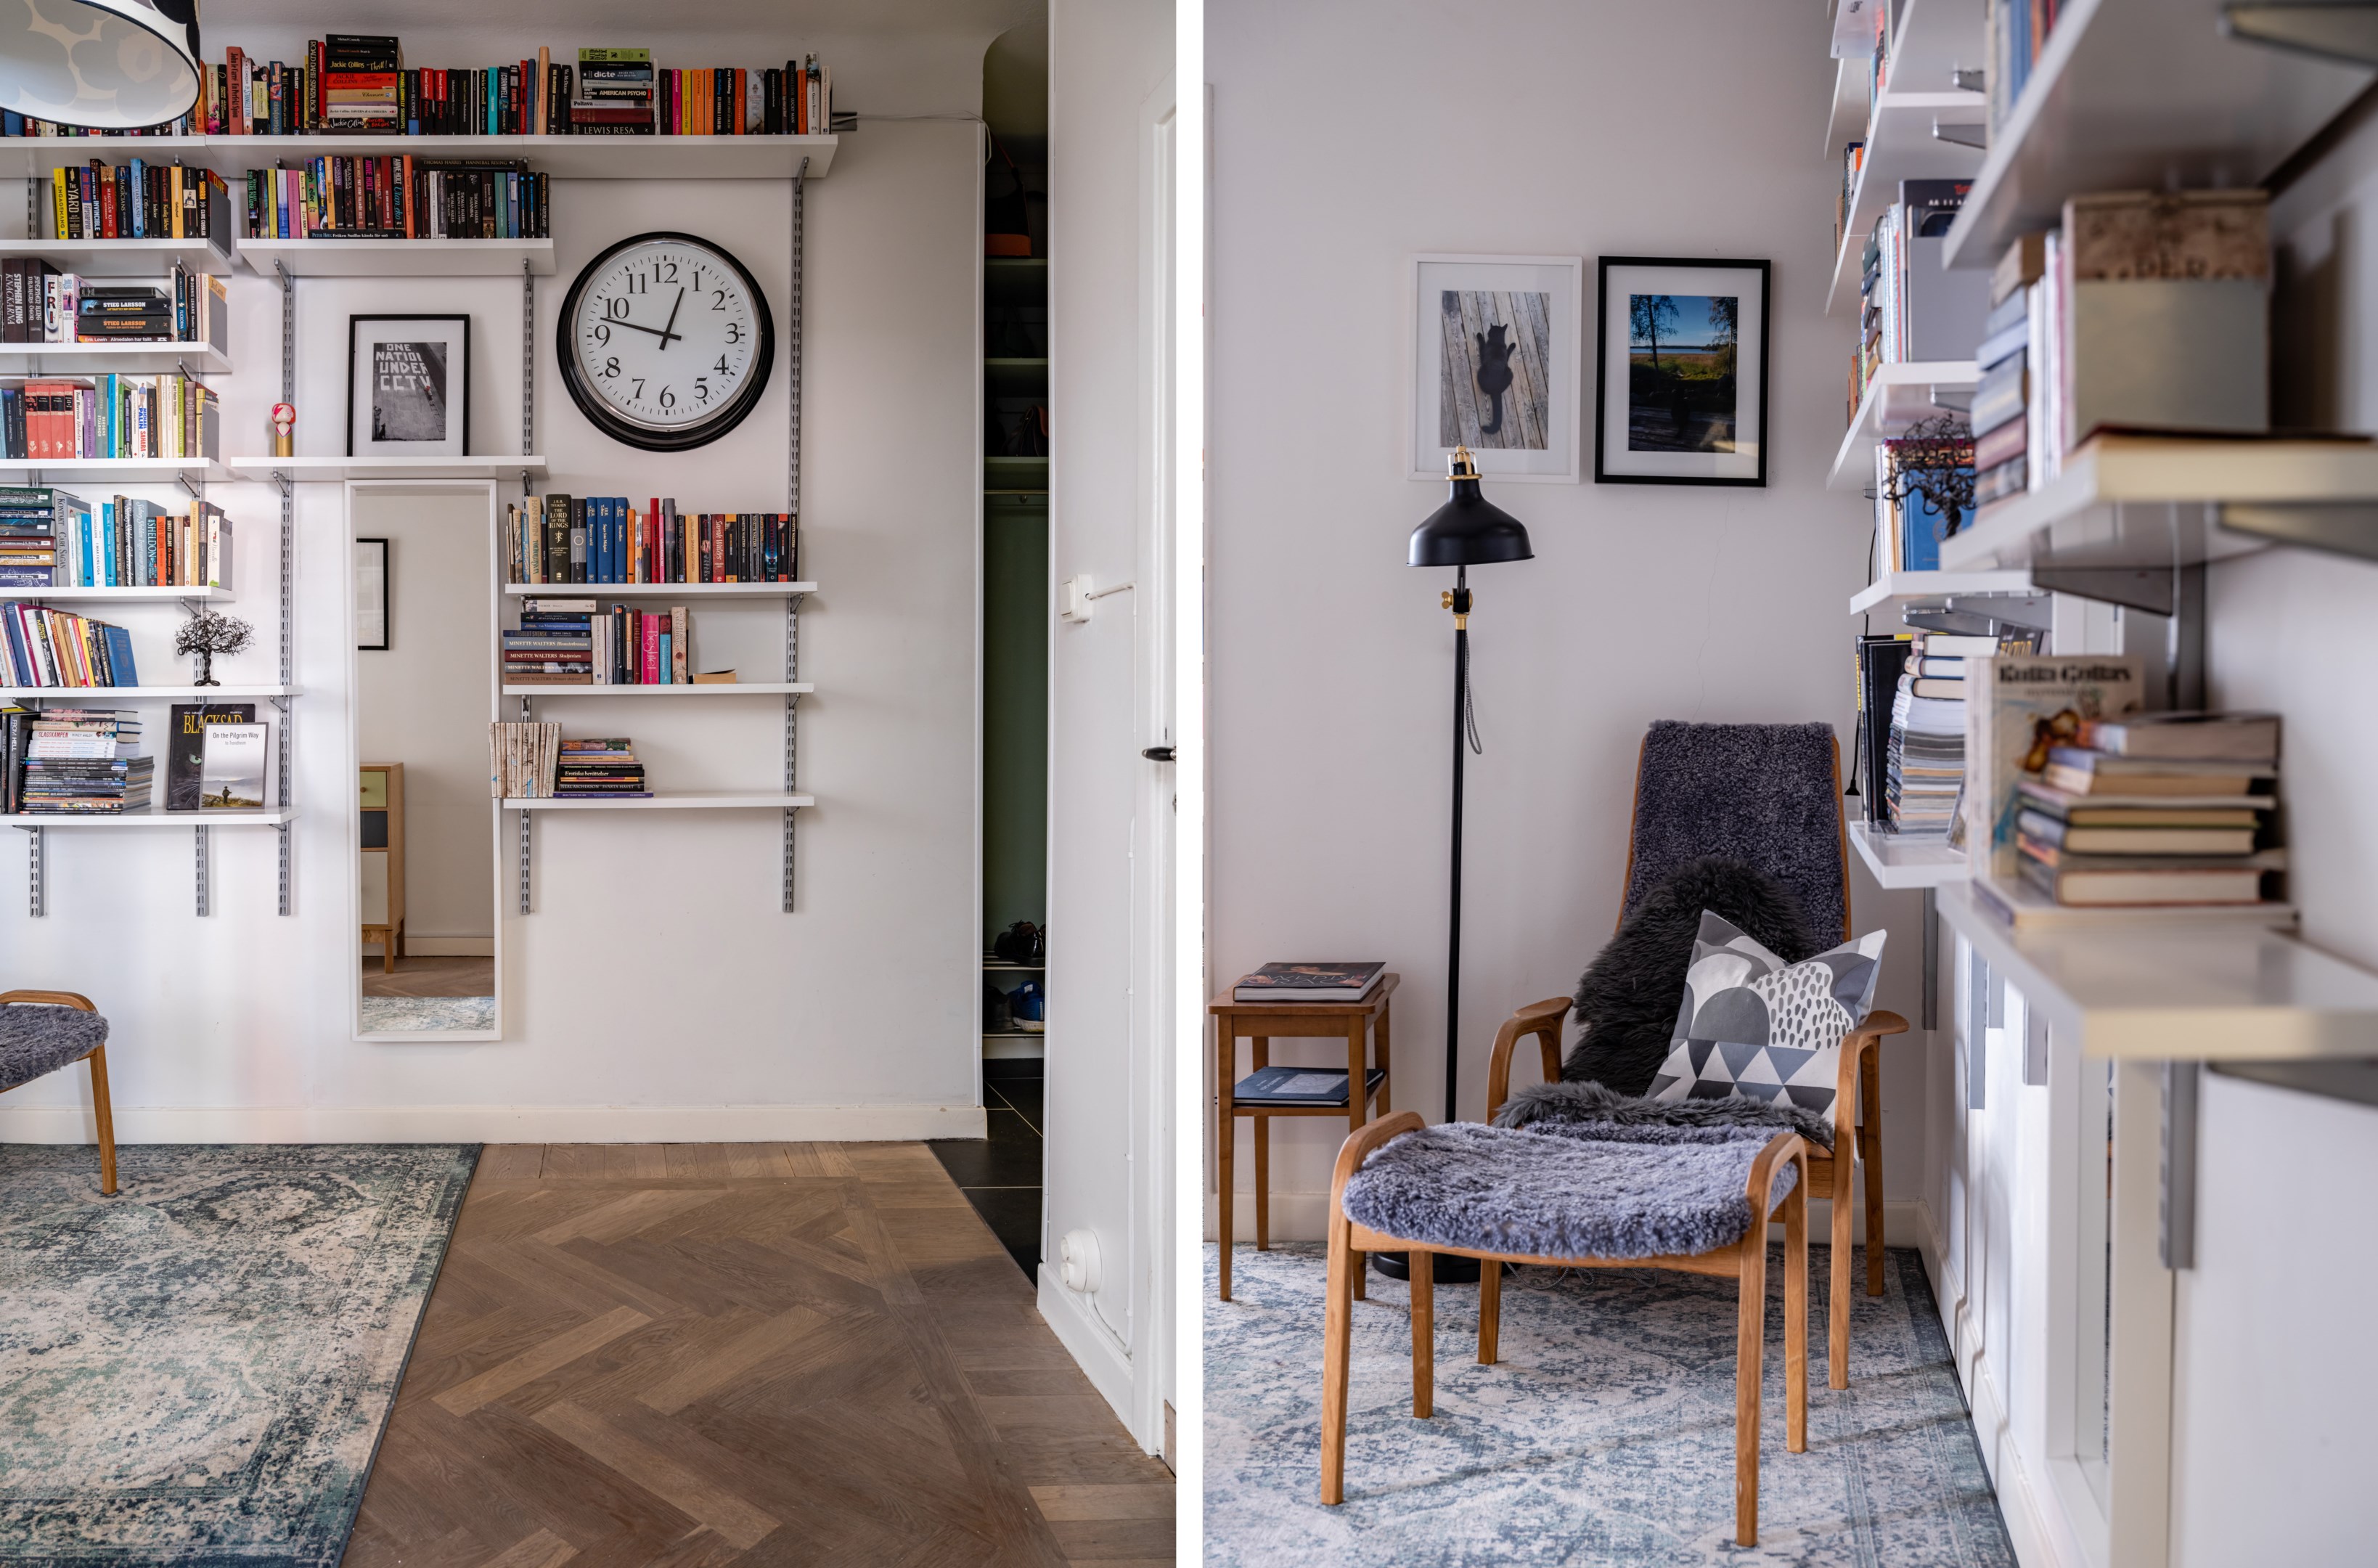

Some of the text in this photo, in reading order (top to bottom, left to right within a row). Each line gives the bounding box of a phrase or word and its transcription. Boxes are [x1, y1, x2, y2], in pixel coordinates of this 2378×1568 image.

[330, 118, 348, 128] Jackie
[68, 189, 79, 213] YARD
[626, 273, 649, 294] 11
[652, 263, 679, 285] 12
[692, 271, 702, 292] 1
[5, 273, 15, 324] KNACKARNA
[14, 274, 23, 324] STEPHEN KING
[604, 298, 630, 319] 10
[711, 290, 726, 311] 2
[594, 324, 611, 348] 9
[724, 323, 739, 344] 3
[380, 362, 430, 374] UNDER
[605, 357, 621, 377] 8
[713, 354, 729, 375] 4
[380, 375, 430, 390] CCTV
[632, 378, 646, 399] 7
[693, 377, 708, 399] 5
[659, 384, 676, 408] 6
[716, 539, 724, 560] Waters
